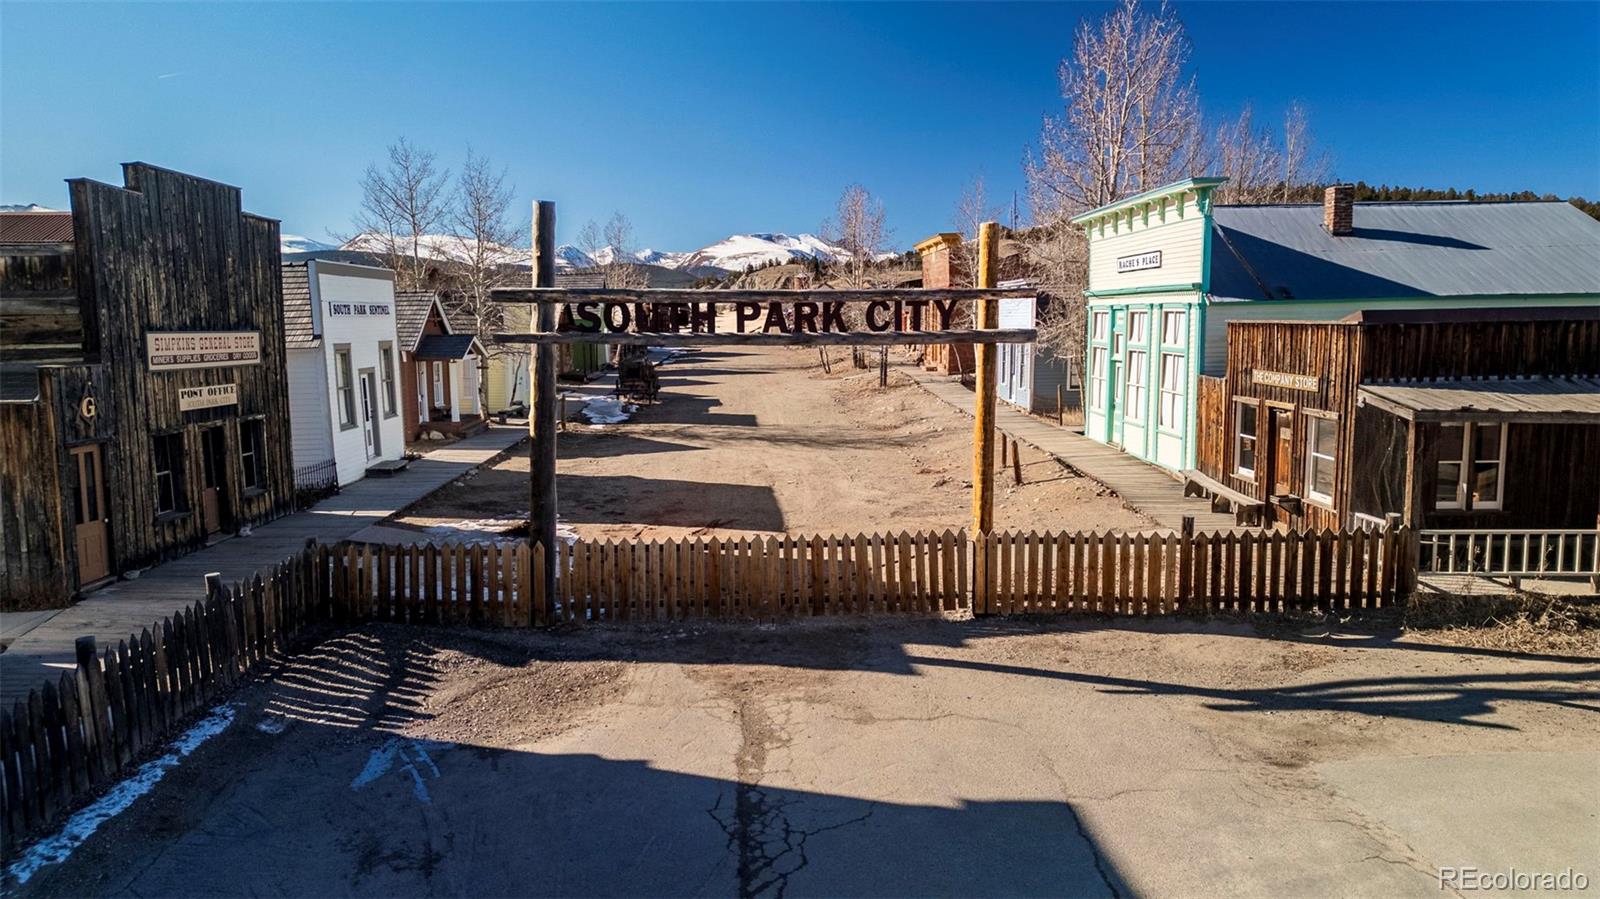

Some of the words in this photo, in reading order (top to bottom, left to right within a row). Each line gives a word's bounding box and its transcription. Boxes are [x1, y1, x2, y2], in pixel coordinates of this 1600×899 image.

[1142, 255, 1158, 266] PLACE
[333, 304, 351, 315] SOUTH
[354, 305, 367, 315] PARK
[369, 305, 390, 315] SENTINEL
[577, 301, 716, 333] SOUTH
[736, 301, 848, 333] PARK
[865, 300, 957, 332] CITY
[154, 337, 196, 352] SIMPKINS
[199, 336, 232, 350] GENERAL
[234, 335, 255, 349] STORE
[176, 355, 201, 363] SUPPLIES
[232, 352, 242, 360] DRY
[1255, 371, 1264, 382] THE
[1264, 372, 1294, 386] COMPANY
[1295, 376, 1317, 389] STORE
[181, 389, 203, 399] POST
[207, 386, 234, 396] OFFICE
[82, 397, 96, 417] G
